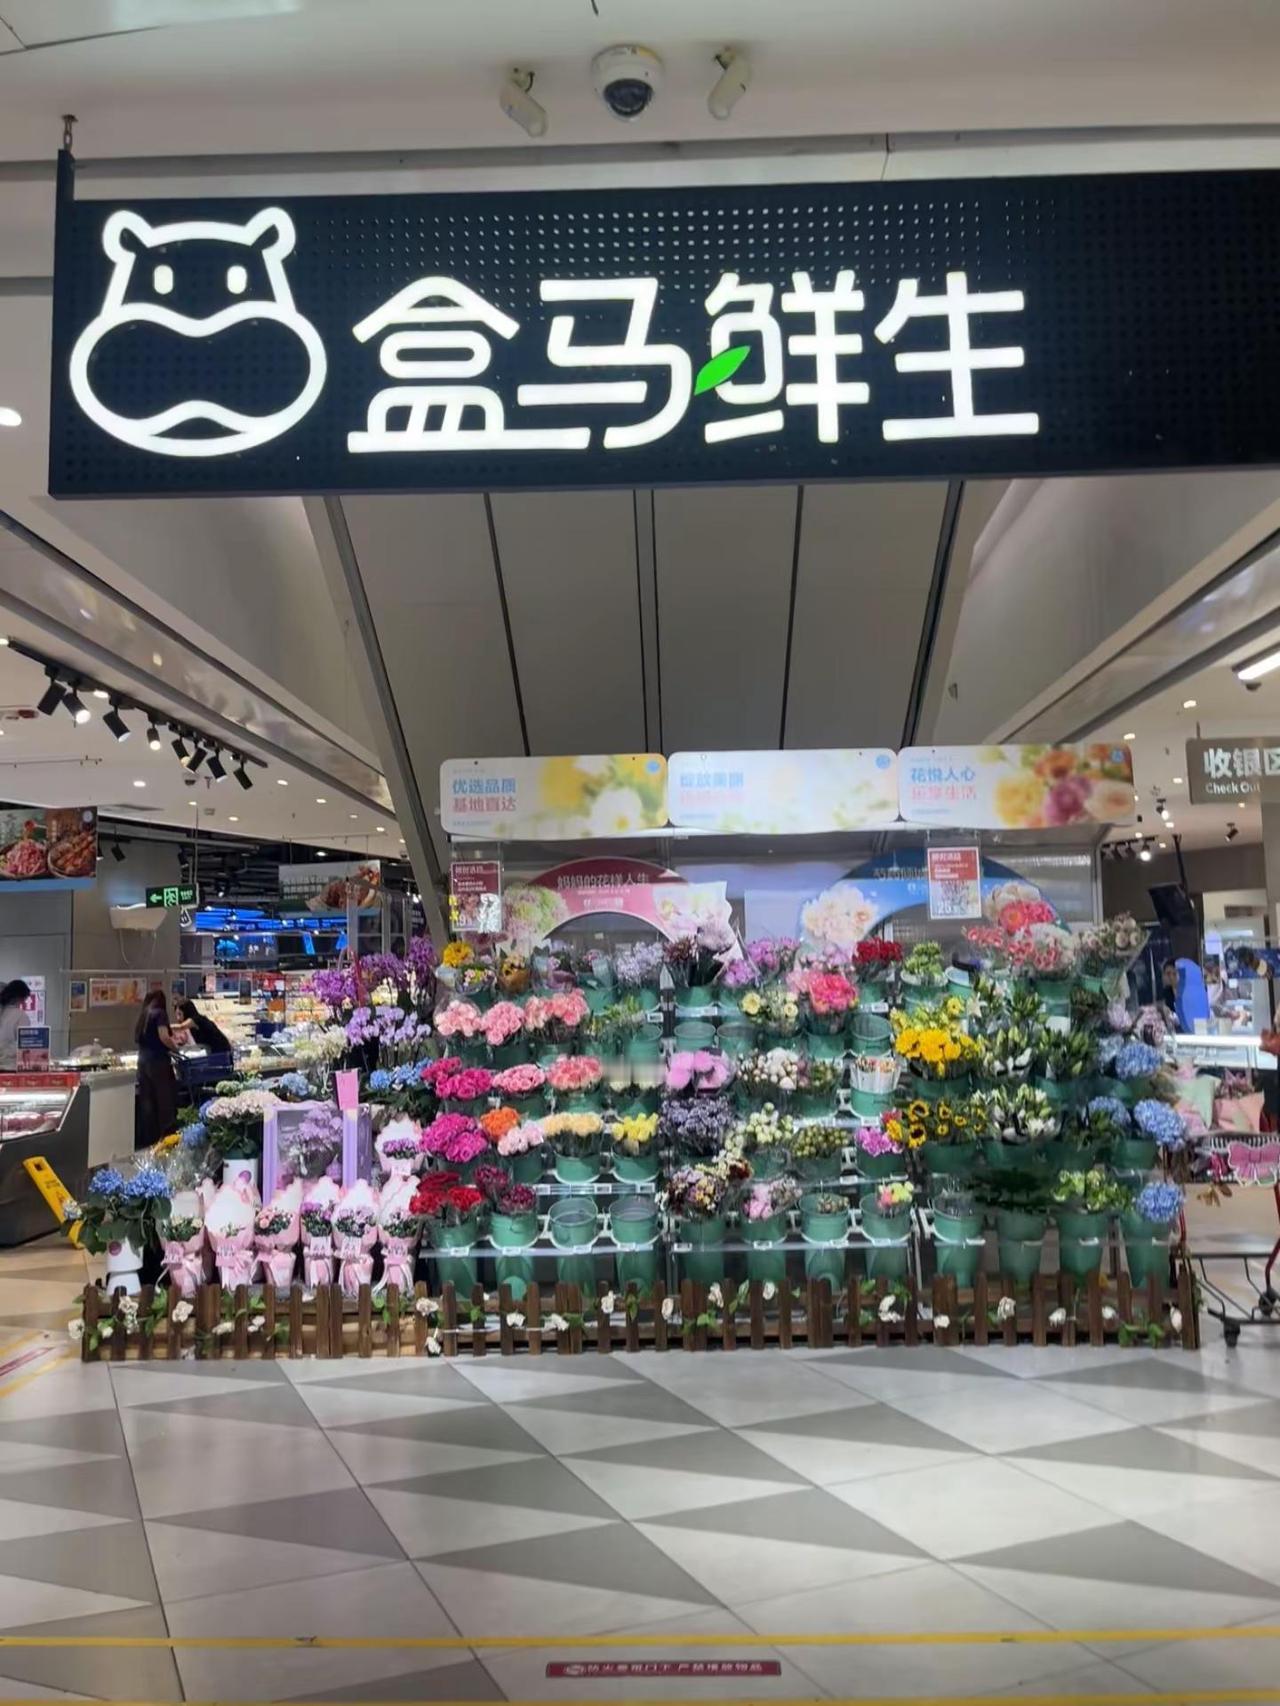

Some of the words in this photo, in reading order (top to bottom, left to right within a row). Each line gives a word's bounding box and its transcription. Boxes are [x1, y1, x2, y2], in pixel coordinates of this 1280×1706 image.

[347, 269, 1040, 454] 盒马鲜生
[1203, 747, 1280, 779] 收银区
[453, 778, 516, 795] 优选品质
[1205, 782, 1239, 794] Check
[453, 796, 517, 813] 基地直达
